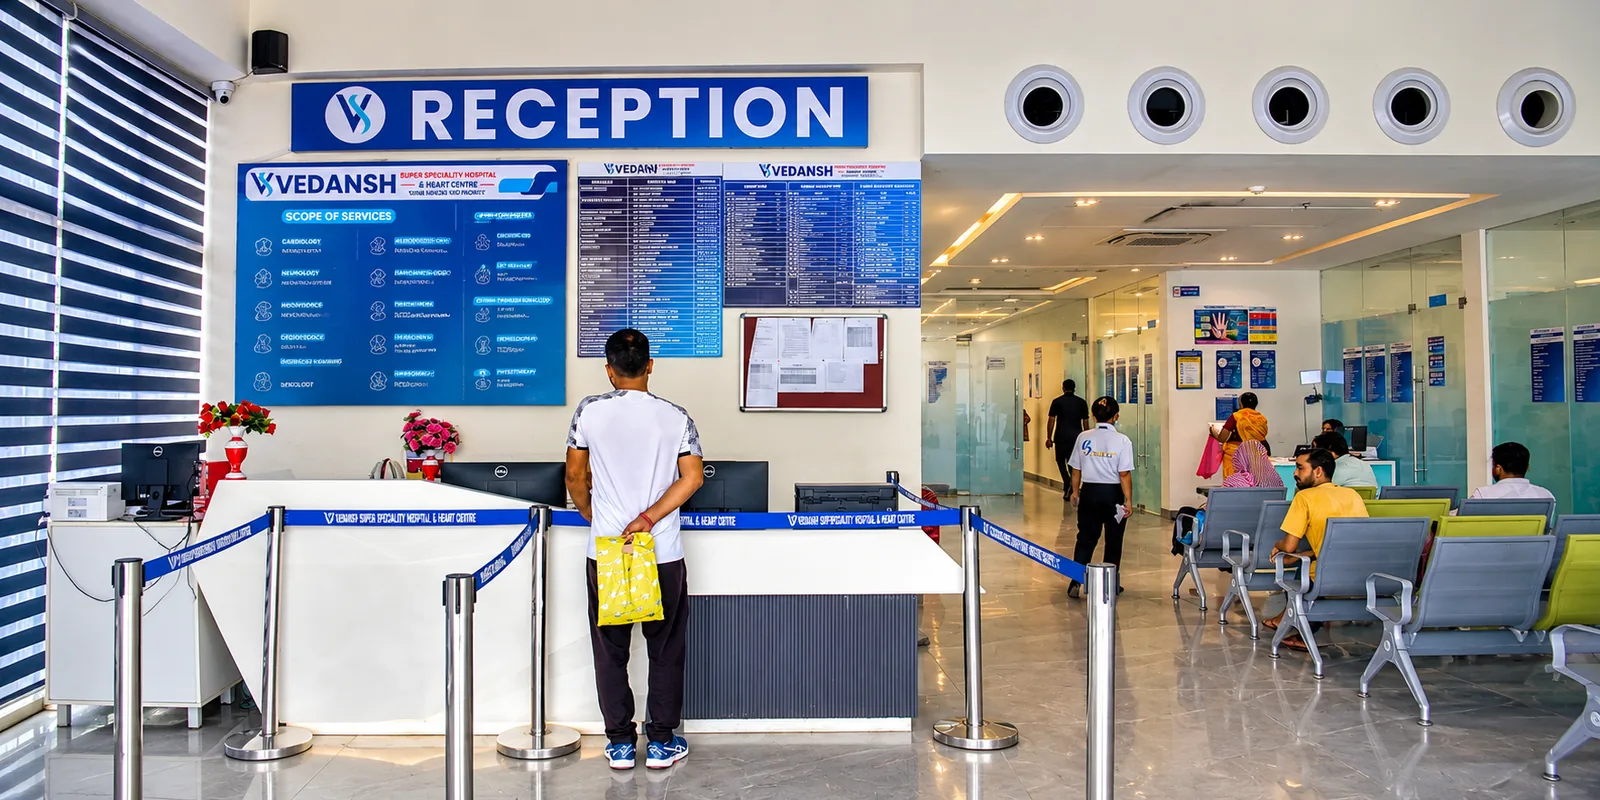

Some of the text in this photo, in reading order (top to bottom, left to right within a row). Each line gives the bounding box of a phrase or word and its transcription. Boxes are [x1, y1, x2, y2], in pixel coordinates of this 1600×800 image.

[412, 86, 844, 140] RECEPTION
[772, 165, 833, 177] VEDANSH
[276, 173, 397, 194] VEDANSH
[450, 180, 478, 188] CENTRE
[285, 211, 392, 221] SCOPE OF SERVICES
